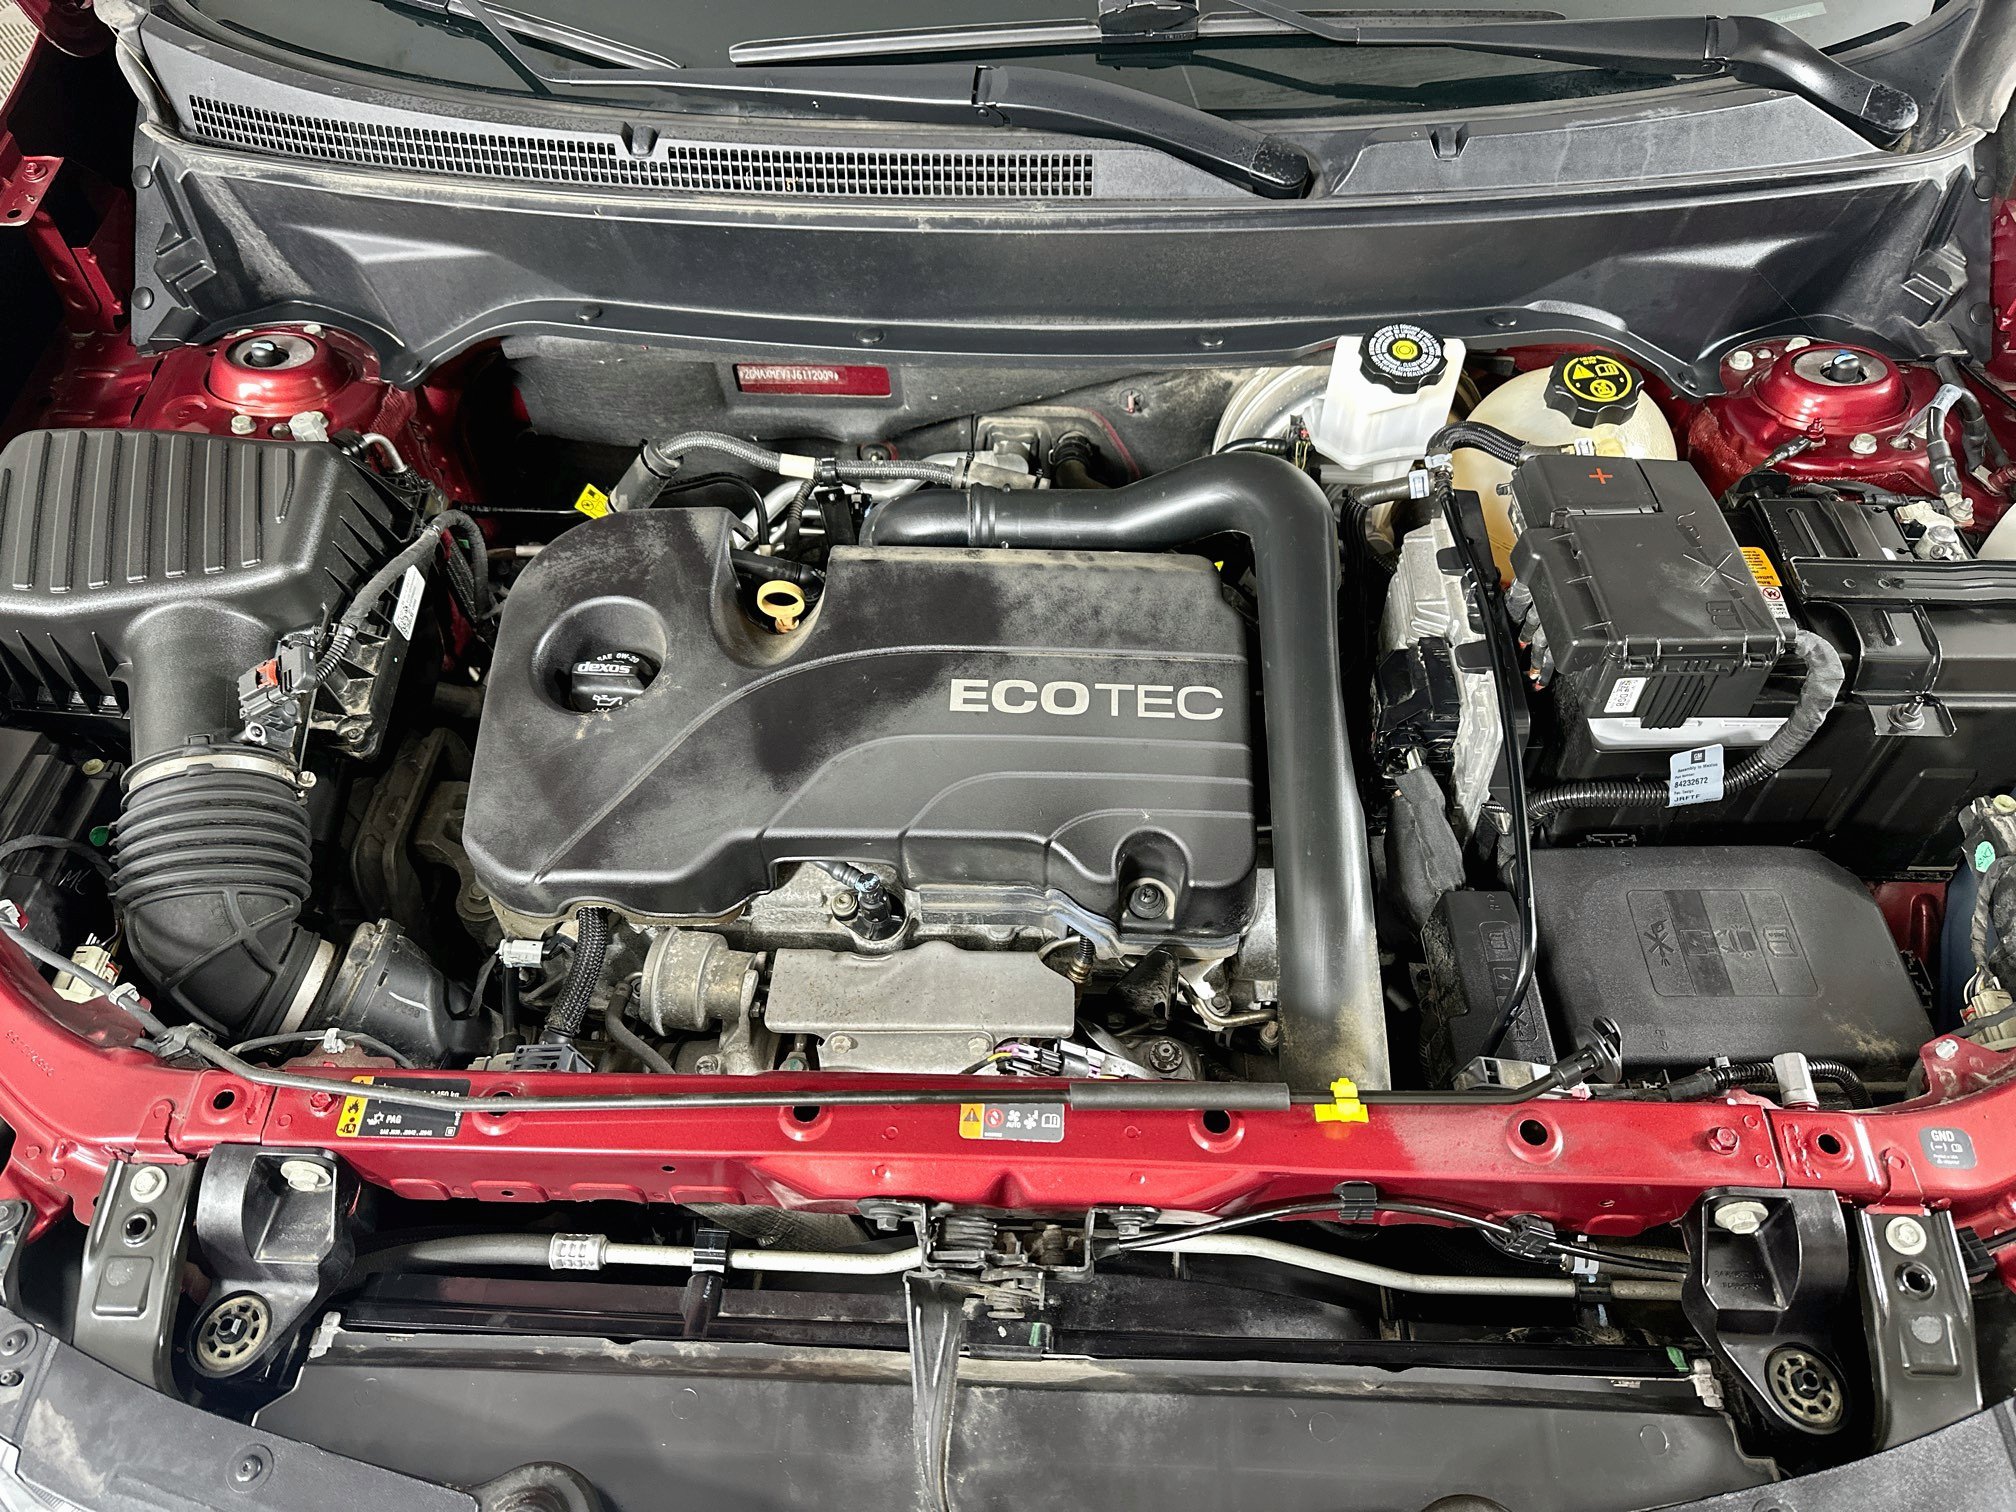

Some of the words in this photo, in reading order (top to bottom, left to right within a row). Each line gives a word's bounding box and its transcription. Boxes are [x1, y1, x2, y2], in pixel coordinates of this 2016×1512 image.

[596, 653, 613, 662] SAE
[615, 652, 640, 664] 0W-20
[577, 661, 633, 674] dexos
[949, 678, 1224, 721] ECOTEC
[1693, 752, 1703, 760] GM
[1674, 776, 1709, 789] 84232672
[385, 1114, 402, 1125] PAG
[1005, 1121, 1022, 1129] AUTO
[1930, 1129, 1955, 1142] GND
